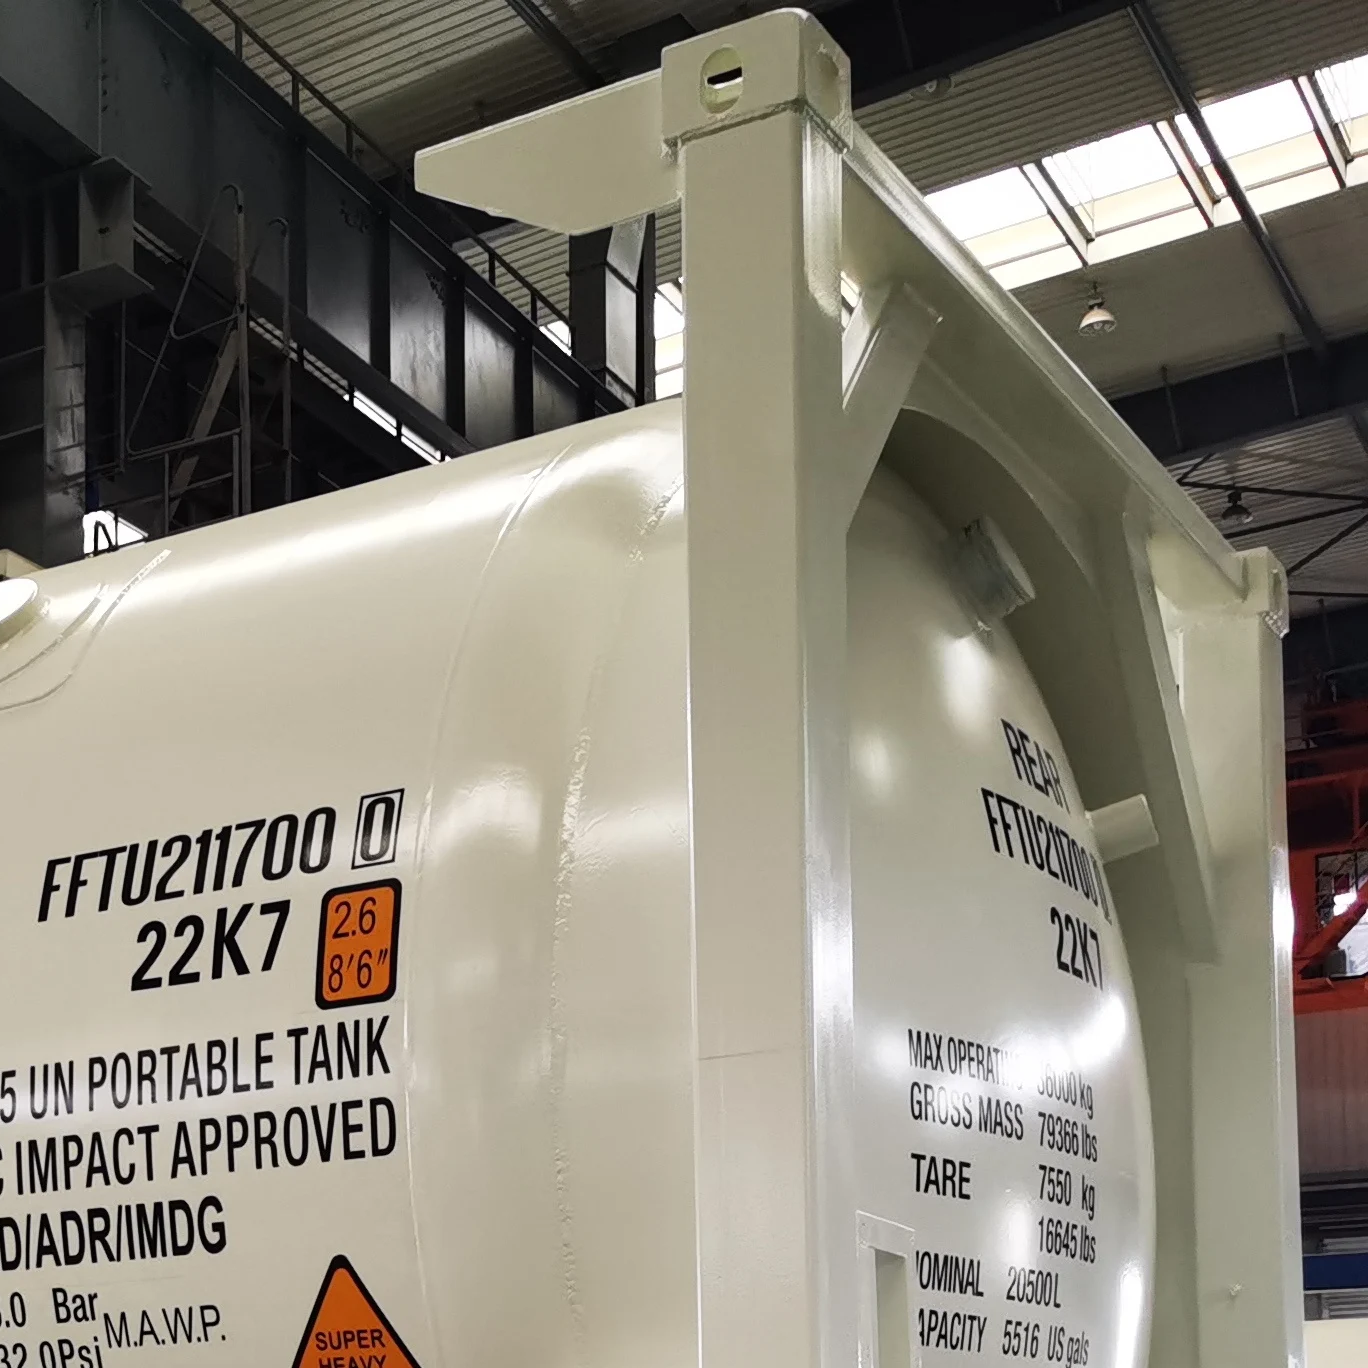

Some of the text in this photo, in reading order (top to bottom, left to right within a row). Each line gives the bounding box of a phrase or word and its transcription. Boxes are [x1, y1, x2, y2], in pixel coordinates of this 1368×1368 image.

[1000, 718, 1070, 815] REAR
[38, 796, 396, 922] FFTU211700 0
[131, 900, 290, 991] 22K7
[332, 896, 377, 940] 2.6
[1050, 906, 1103, 990] 22K7
[30, 1060, 75, 1120] UN
[89, 1031, 274, 1112] PORTABLE
[287, 1014, 391, 1086] TANK
[908, 1028, 944, 1072] MAX
[16, 1124, 160, 1195] IMPACT
[171, 1096, 397, 1179] APPROVED
[910, 1081, 973, 1130] GROSS
[978, 1096, 1024, 1141] MASS
[1038, 1111, 1079, 1157] 79366
[910, 1152, 1096, 1221] TARE 7550 kg
[1038, 1216, 1078, 1259] 16645
[916, 1250, 984, 1297] OMINAL
[52, 1287, 98, 1324] Bar
[103, 1304, 226, 1349] M.A.W.P.
[919, 1307, 987, 1353] APACITY
[1002, 1319, 1040, 1359] 5516
[315, 1328, 386, 1352] SUPER
